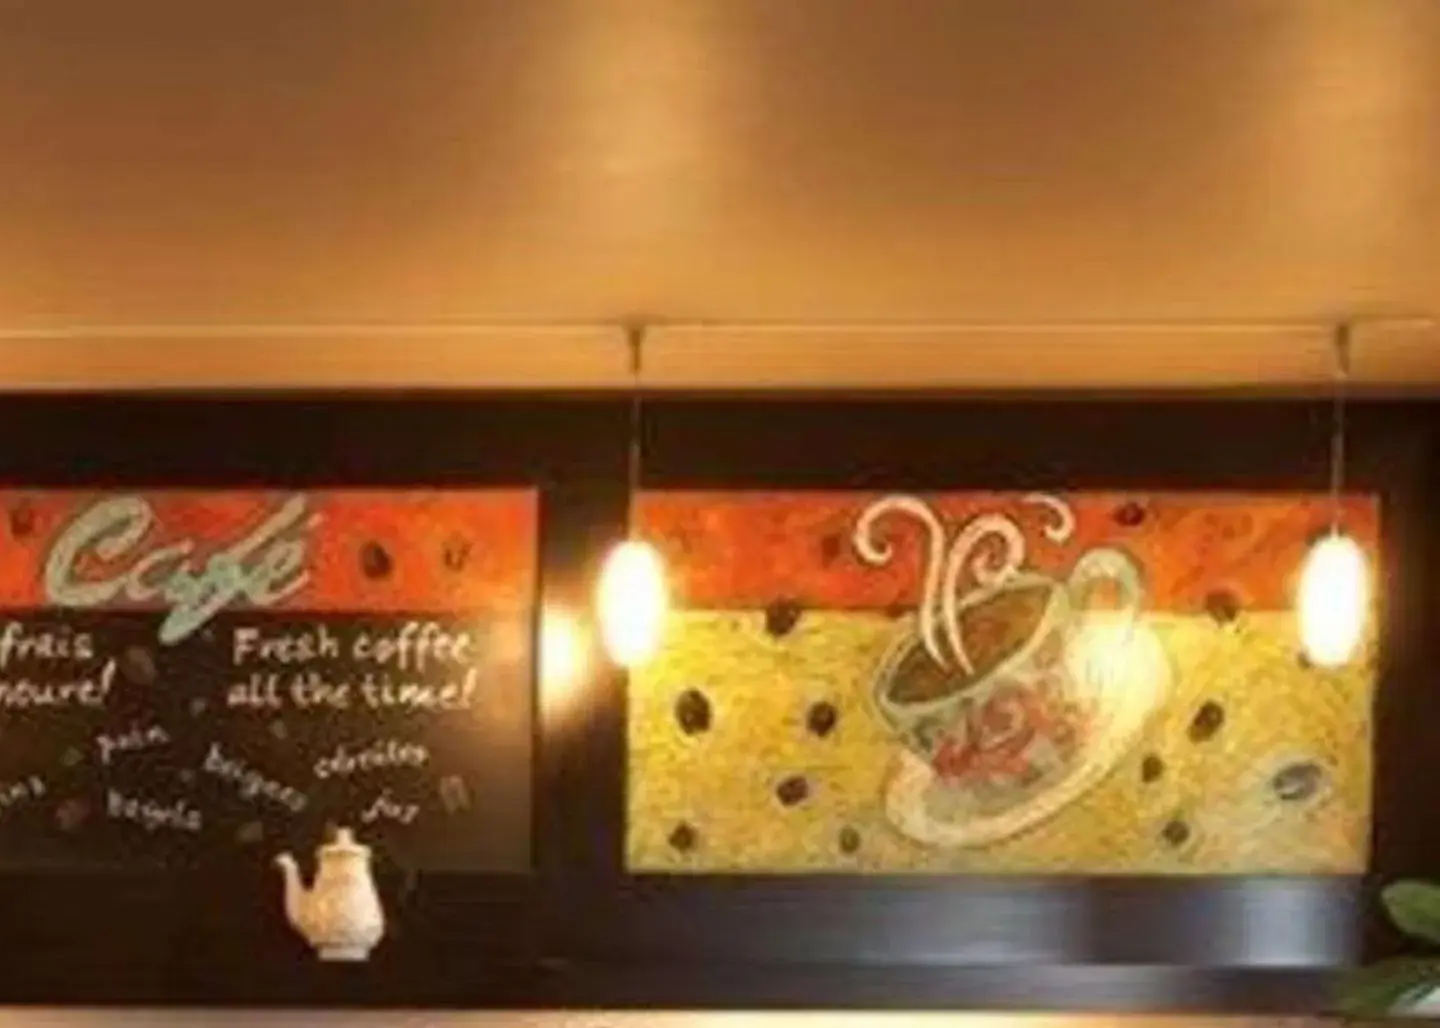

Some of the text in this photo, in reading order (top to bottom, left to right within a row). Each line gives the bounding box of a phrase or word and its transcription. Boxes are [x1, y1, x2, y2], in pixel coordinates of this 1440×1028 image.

[46, 495, 324, 647] Café
[232, 620, 473, 674] Fresh coffee
[227, 667, 479, 710] all the time!
